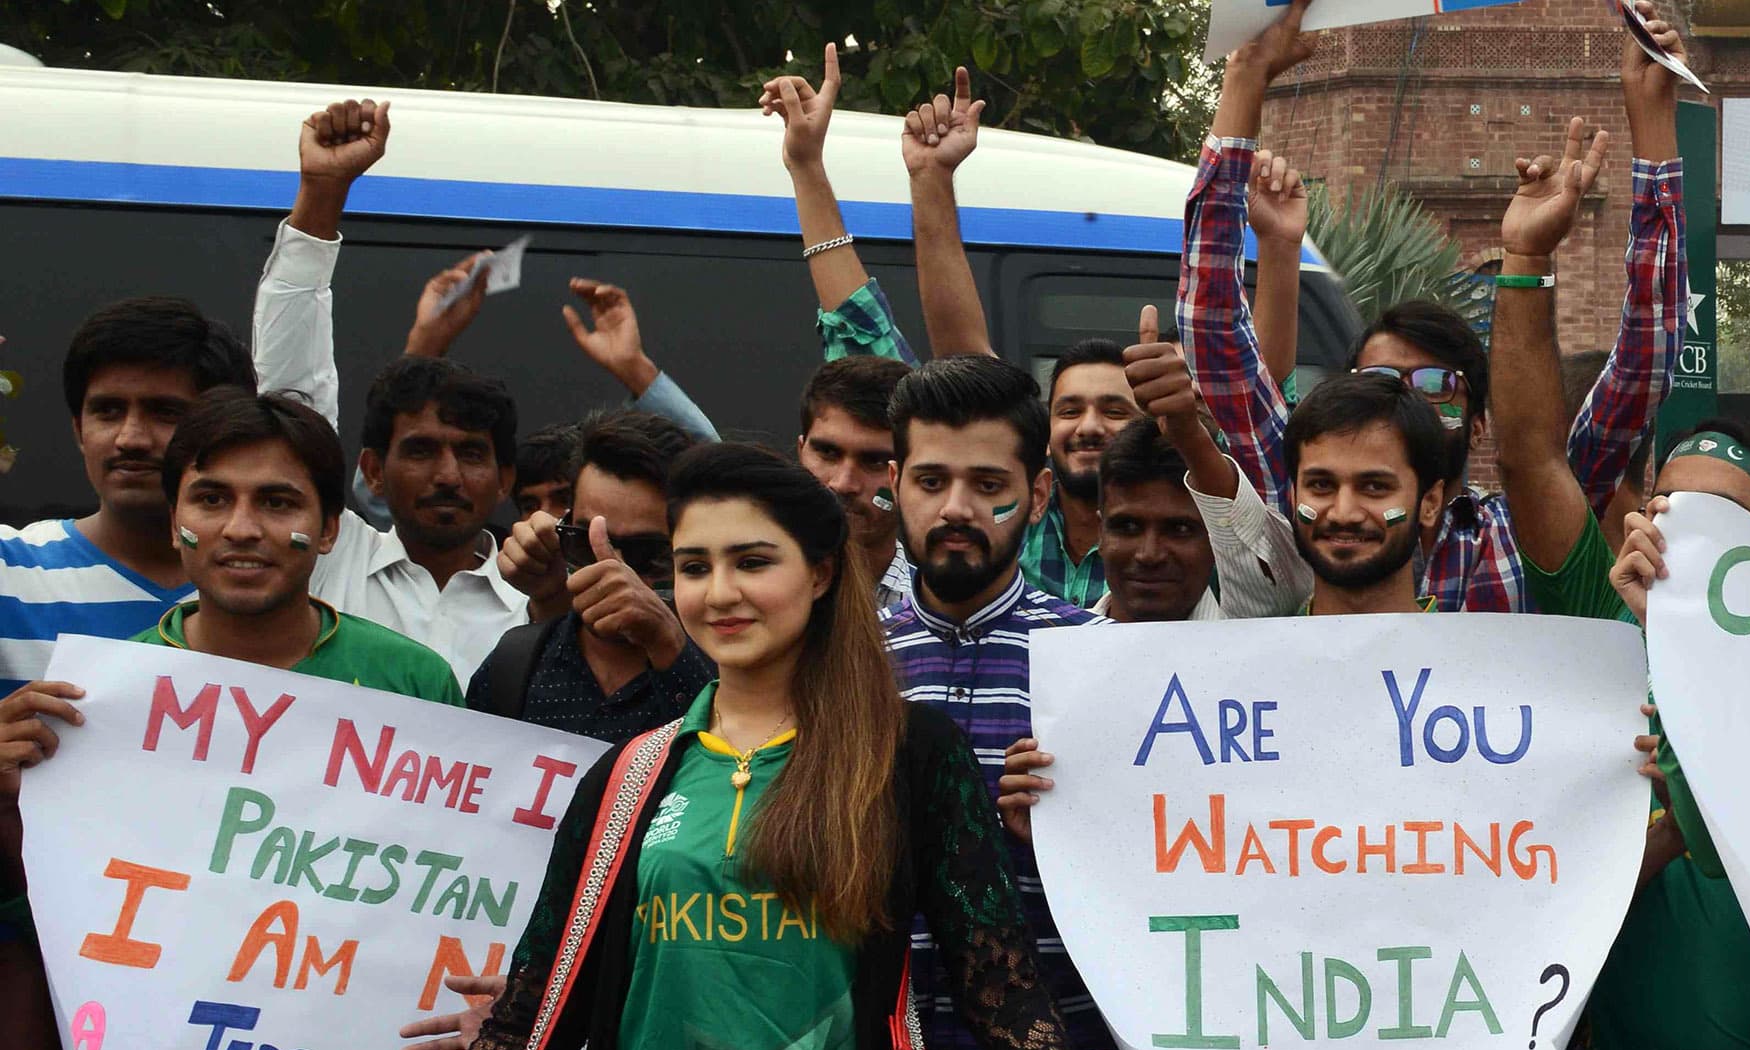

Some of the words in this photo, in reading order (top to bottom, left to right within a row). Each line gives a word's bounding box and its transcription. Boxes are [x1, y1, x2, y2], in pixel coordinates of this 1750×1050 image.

[1679, 345, 1708, 374] CB
[142, 675, 296, 775] MY
[322, 718, 492, 814] NAME
[1133, 672, 1281, 767] ARE
[1381, 667, 1533, 768] YOU
[209, 786, 519, 928] PAKISTAN
[1153, 793, 1558, 885] WATCHING
[79, 857, 191, 969] I
[226, 900, 360, 996] AM
[416, 934, 507, 1013] N
